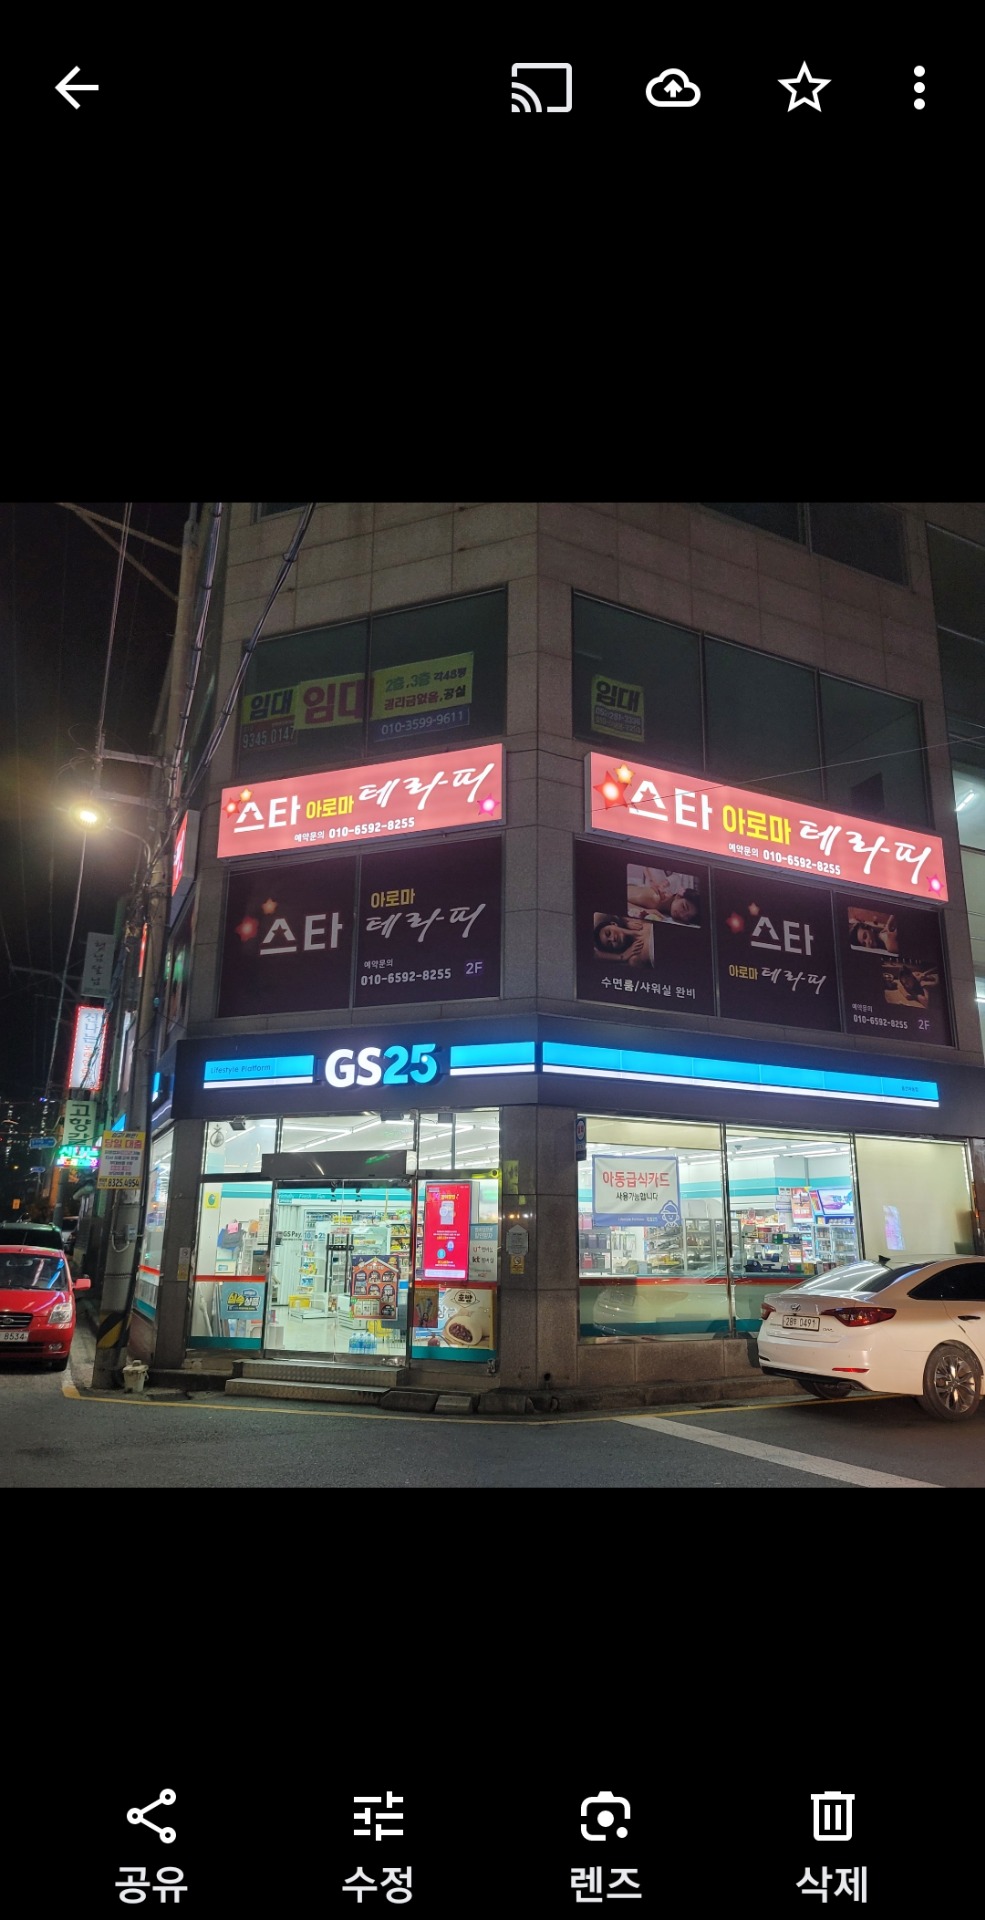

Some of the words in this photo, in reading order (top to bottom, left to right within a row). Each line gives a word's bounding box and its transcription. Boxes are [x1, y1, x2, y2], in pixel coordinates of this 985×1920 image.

[250, 689, 293, 721] 임대
[303, 676, 375, 724] 임대
[597, 681, 640, 712] 임대
[381, 711, 464, 735] 010-3599-9611
[233, 795, 301, 833] 스타
[305, 795, 355, 819] 아로마
[628, 780, 713, 830] 스타
[722, 804, 792, 845] 아로마
[294, 830, 325, 843] 예약문의
[328, 817, 415, 840] 010-6592-8255
[728, 842, 759, 858] 예약문의
[762, 848, 841, 876] 010-6592-8255
[370, 888, 416, 909] 아로마
[260, 912, 343, 956] 스타
[750, 916, 814, 956] 스타
[360, 968, 452, 986] 010-6592-8255
[465, 961, 483, 975] 2F
[363, 958, 393, 970] 예약문의
[728, 964, 759, 980] 아로마
[600, 976, 672, 998] 수면룸/샤워실
[675, 985, 696, 1000] 완비
[851, 1002, 873, 1013] 예약문의
[853, 1014, 909, 1031] 010-6592-8255
[918, 1019, 931, 1031] 2F
[211, 1066, 239, 1075] Lifestyle
[241, 1065, 271, 1073] Platform
[324, 1043, 438, 1088] GS25
[602, 1171, 670, 1188] 아동급식카드
[616, 1192, 659, 1201] 사용가능합니다
[4, 1332, 24, 1340] 8534
